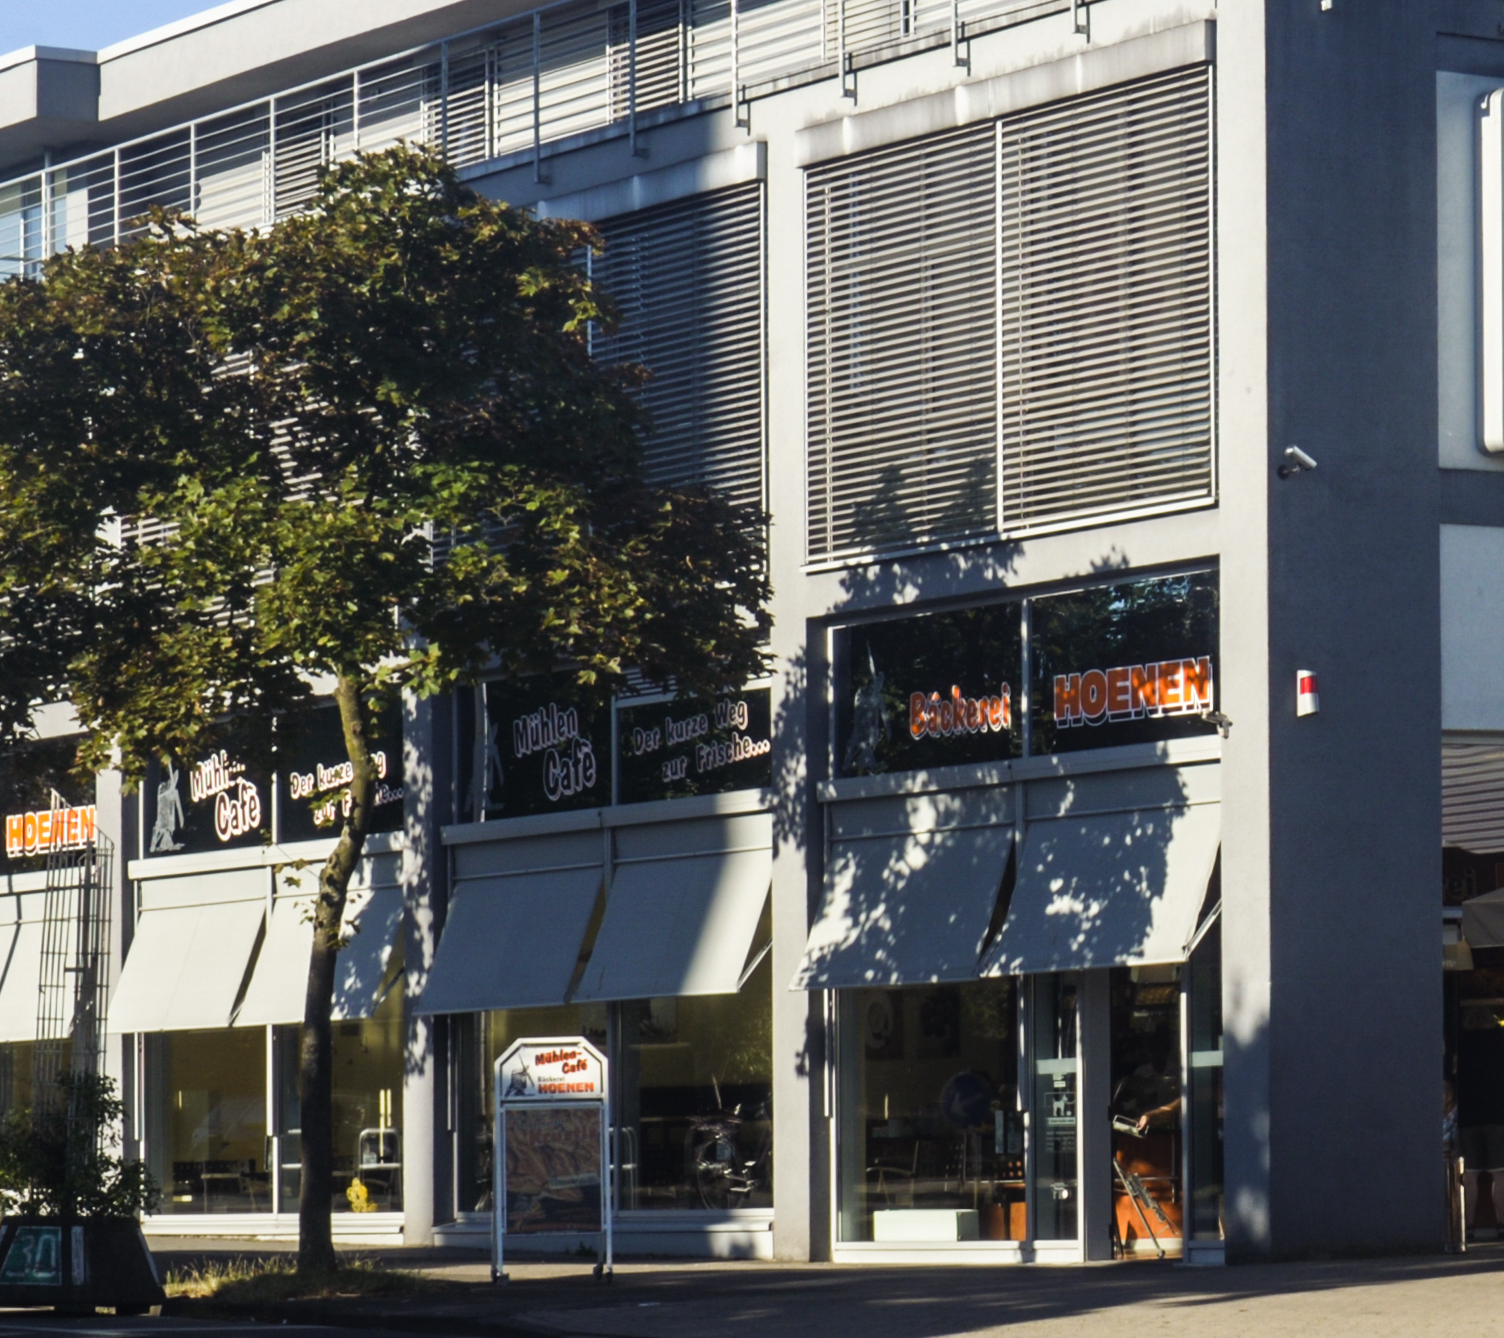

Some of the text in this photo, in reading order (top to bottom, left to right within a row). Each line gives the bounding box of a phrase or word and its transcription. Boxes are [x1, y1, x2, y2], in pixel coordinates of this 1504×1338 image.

[909, 656, 1214, 741] Bäckerei HOENEN
[513, 702, 579, 758] Mühlen
[633, 698, 749, 755] Der kurze Weg
[290, 772, 314, 799] Der
[543, 736, 597, 801] Café
[661, 756, 687, 782] zur
[6, 804, 97, 858] HOENEN
[215, 776, 261, 841] Café
[535, 1048, 582, 1066] Mühlen-
[562, 1058, 588, 1074] Café
[538, 1082, 594, 1094] HOENEN
